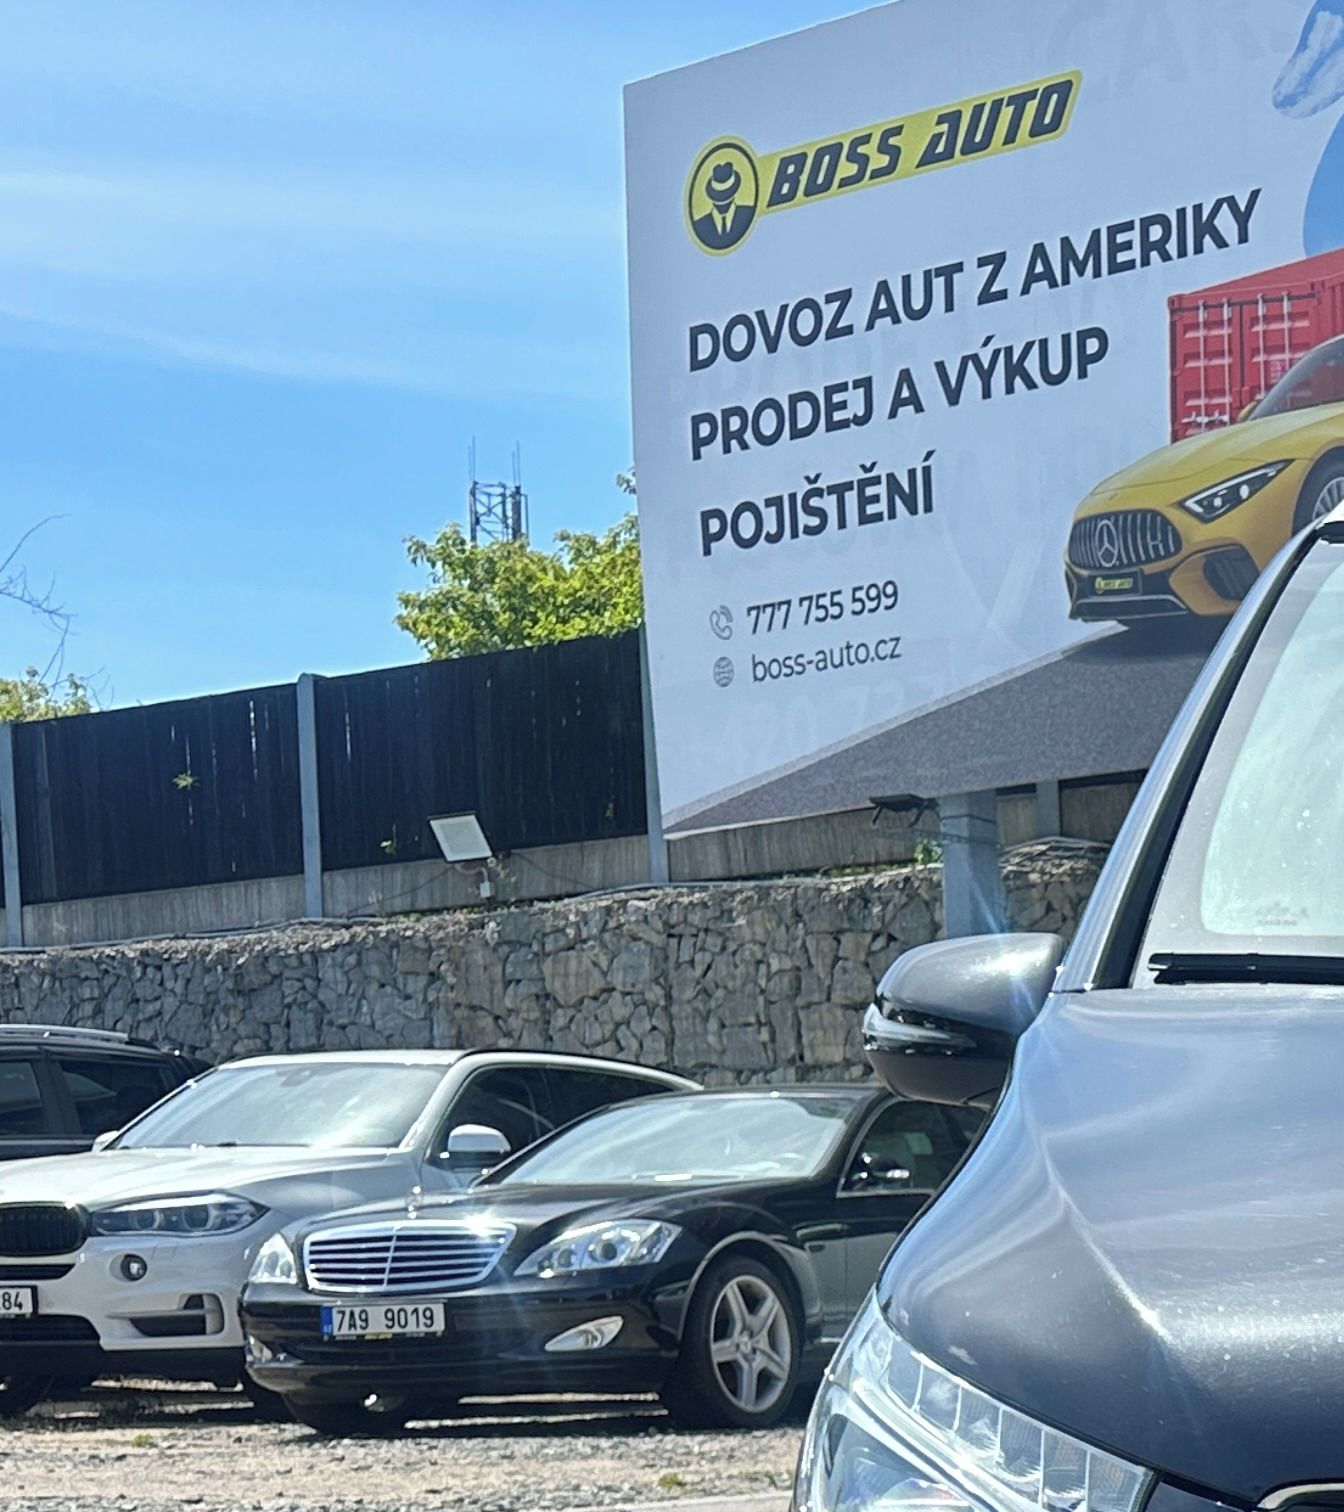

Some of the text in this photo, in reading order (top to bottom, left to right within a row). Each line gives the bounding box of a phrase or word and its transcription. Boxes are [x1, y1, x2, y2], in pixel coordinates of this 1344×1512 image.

[766, 79, 1074, 209] BOSS AUTO
[688, 188, 1262, 373] DOVOZ AUT Z AMERIKY
[691, 326, 1110, 462] PRODEJ A VÝKUP
[700, 449, 936, 556] POJIŠTĚNÍ
[746, 580, 899, 636] 777 755 599
[751, 636, 902, 683] boss-auto.cz
[336, 1306, 434, 1332] 7A9 9019
